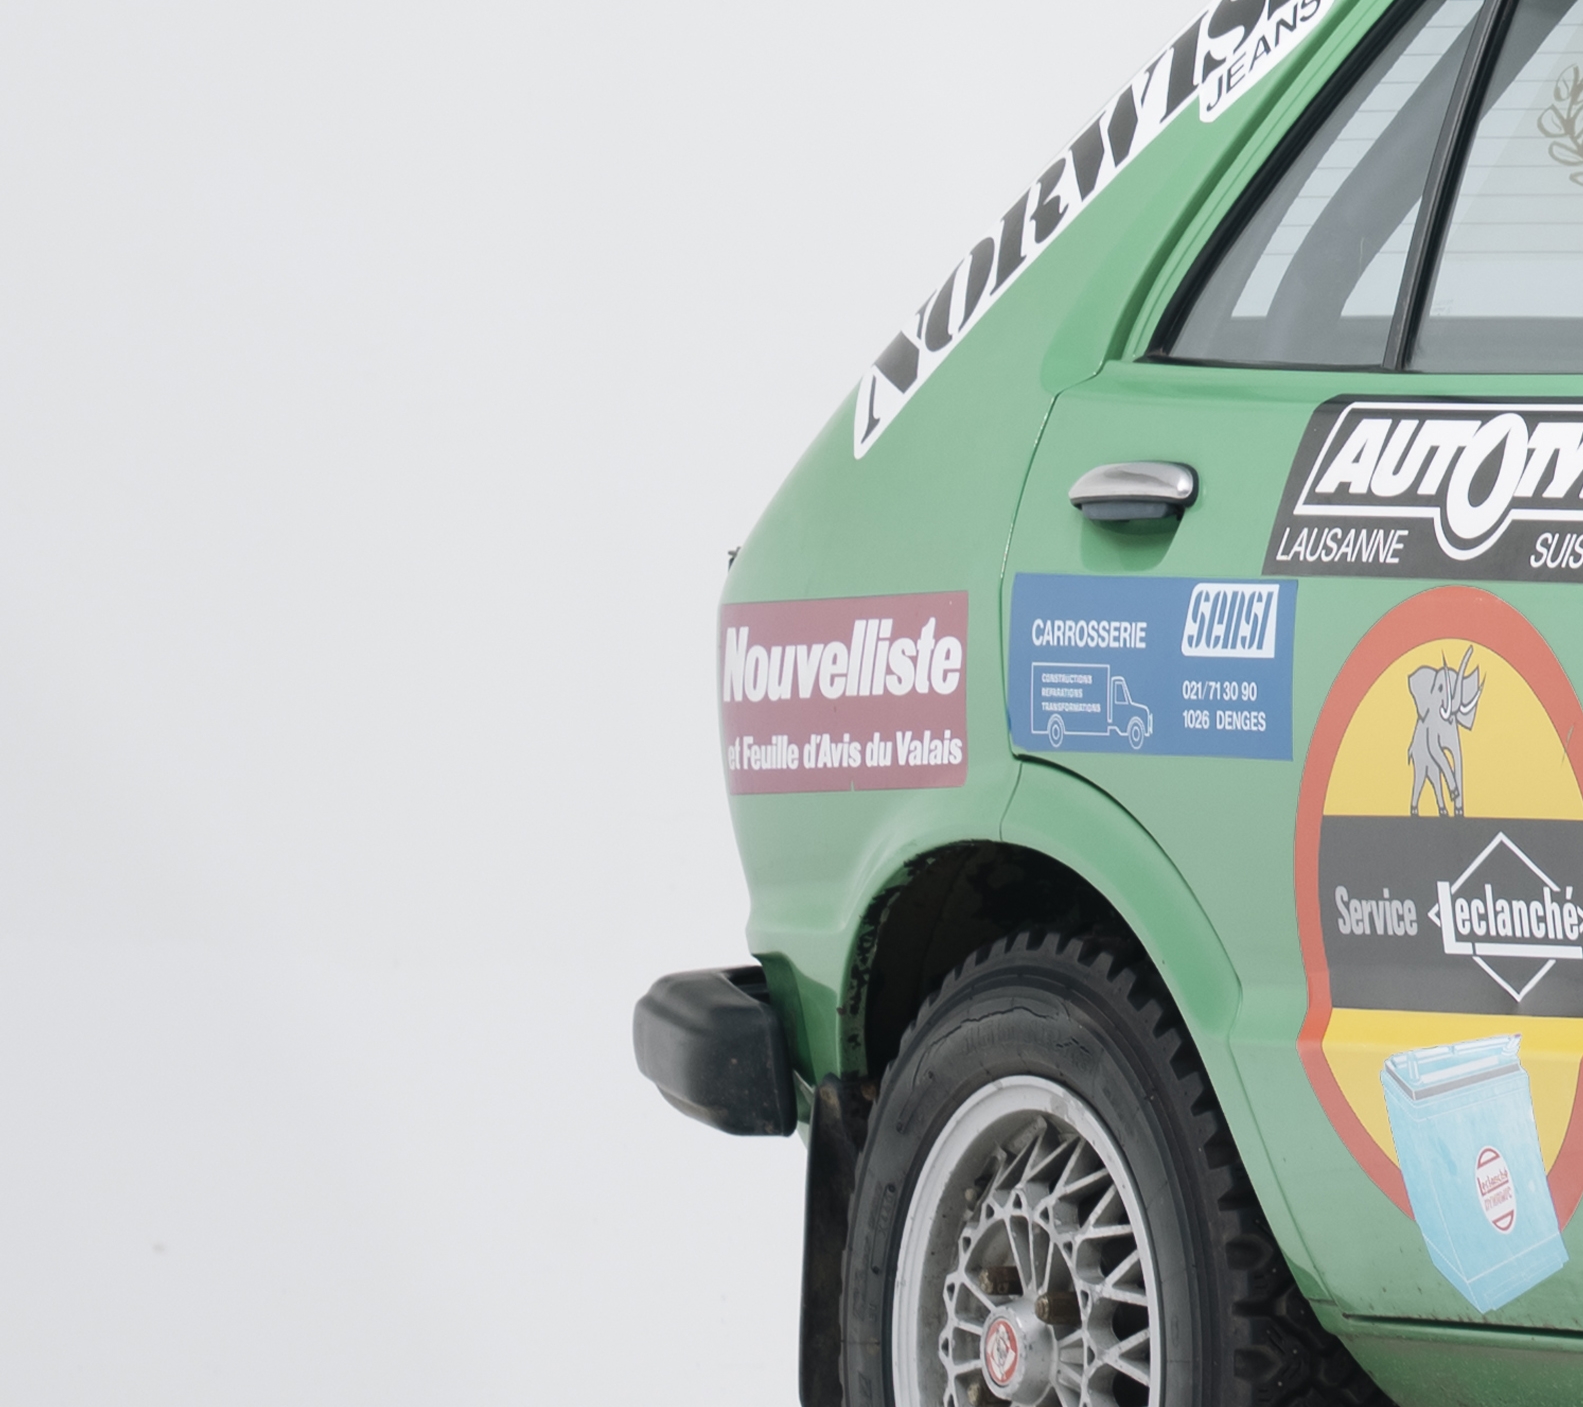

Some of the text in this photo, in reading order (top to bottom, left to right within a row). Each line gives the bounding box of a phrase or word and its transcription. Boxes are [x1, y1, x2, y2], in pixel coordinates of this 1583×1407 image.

[1276, 527, 1409, 565] LAUSANNE
[1031, 618, 1147, 648] CARROSSERIE
[723, 617, 963, 702] Nouvelliste
[1241, 683, 1257, 701] 90
[1183, 710, 1266, 731] 1026 DENGES
[728, 729, 963, 771] et Feuille d'Avis du Valais
[1335, 881, 1583, 959] Service Leclanché
